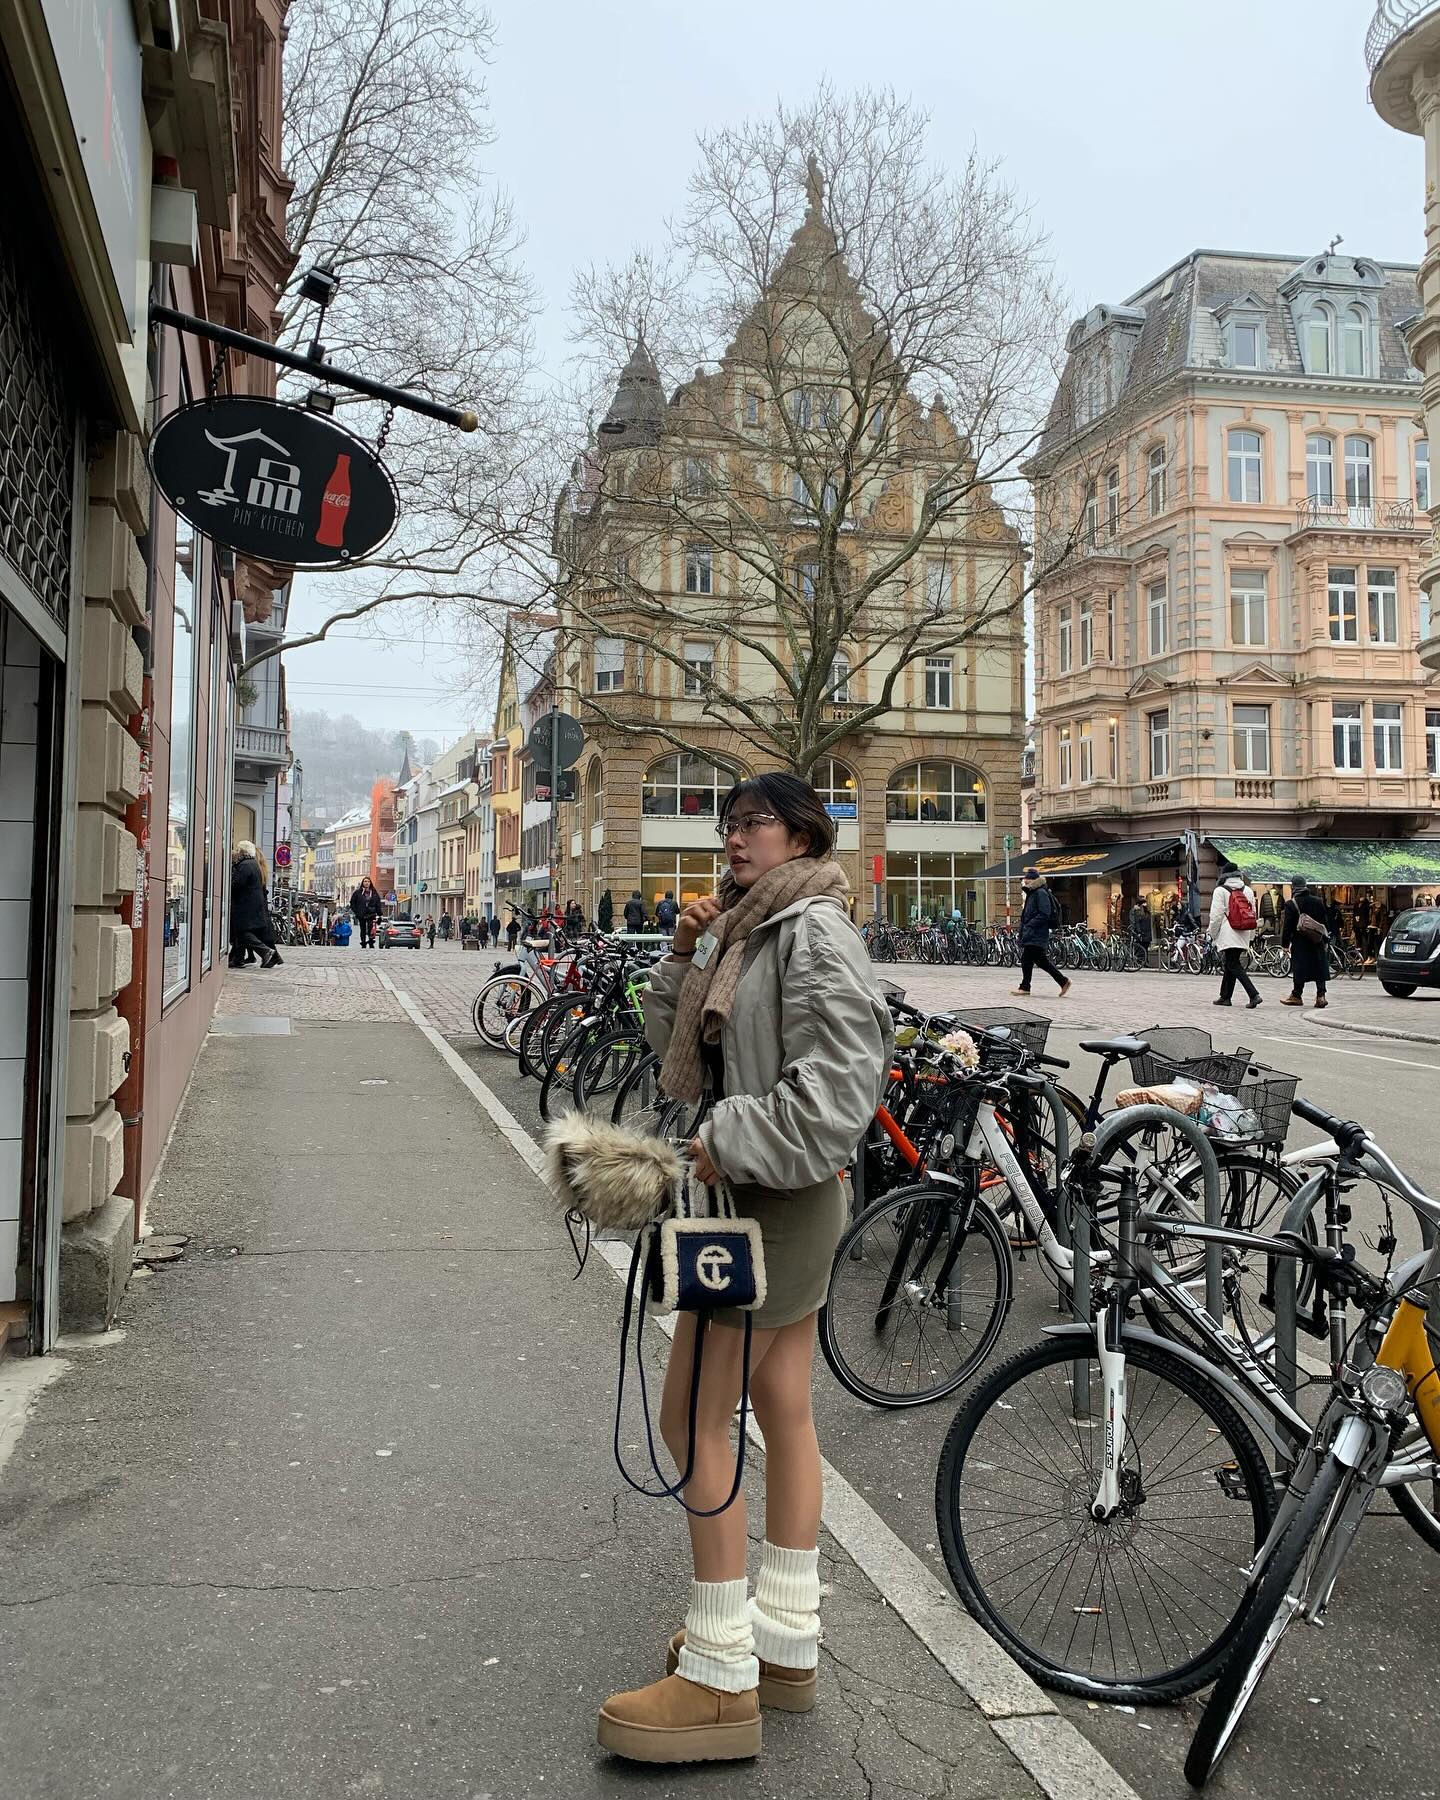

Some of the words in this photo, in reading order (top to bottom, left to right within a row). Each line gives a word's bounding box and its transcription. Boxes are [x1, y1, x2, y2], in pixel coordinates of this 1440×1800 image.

[260, 513, 305, 538] KITCHEN
[1163, 1281, 1284, 1398] SCOTT
[1105, 1421, 1114, 1454] SUNTOUR
